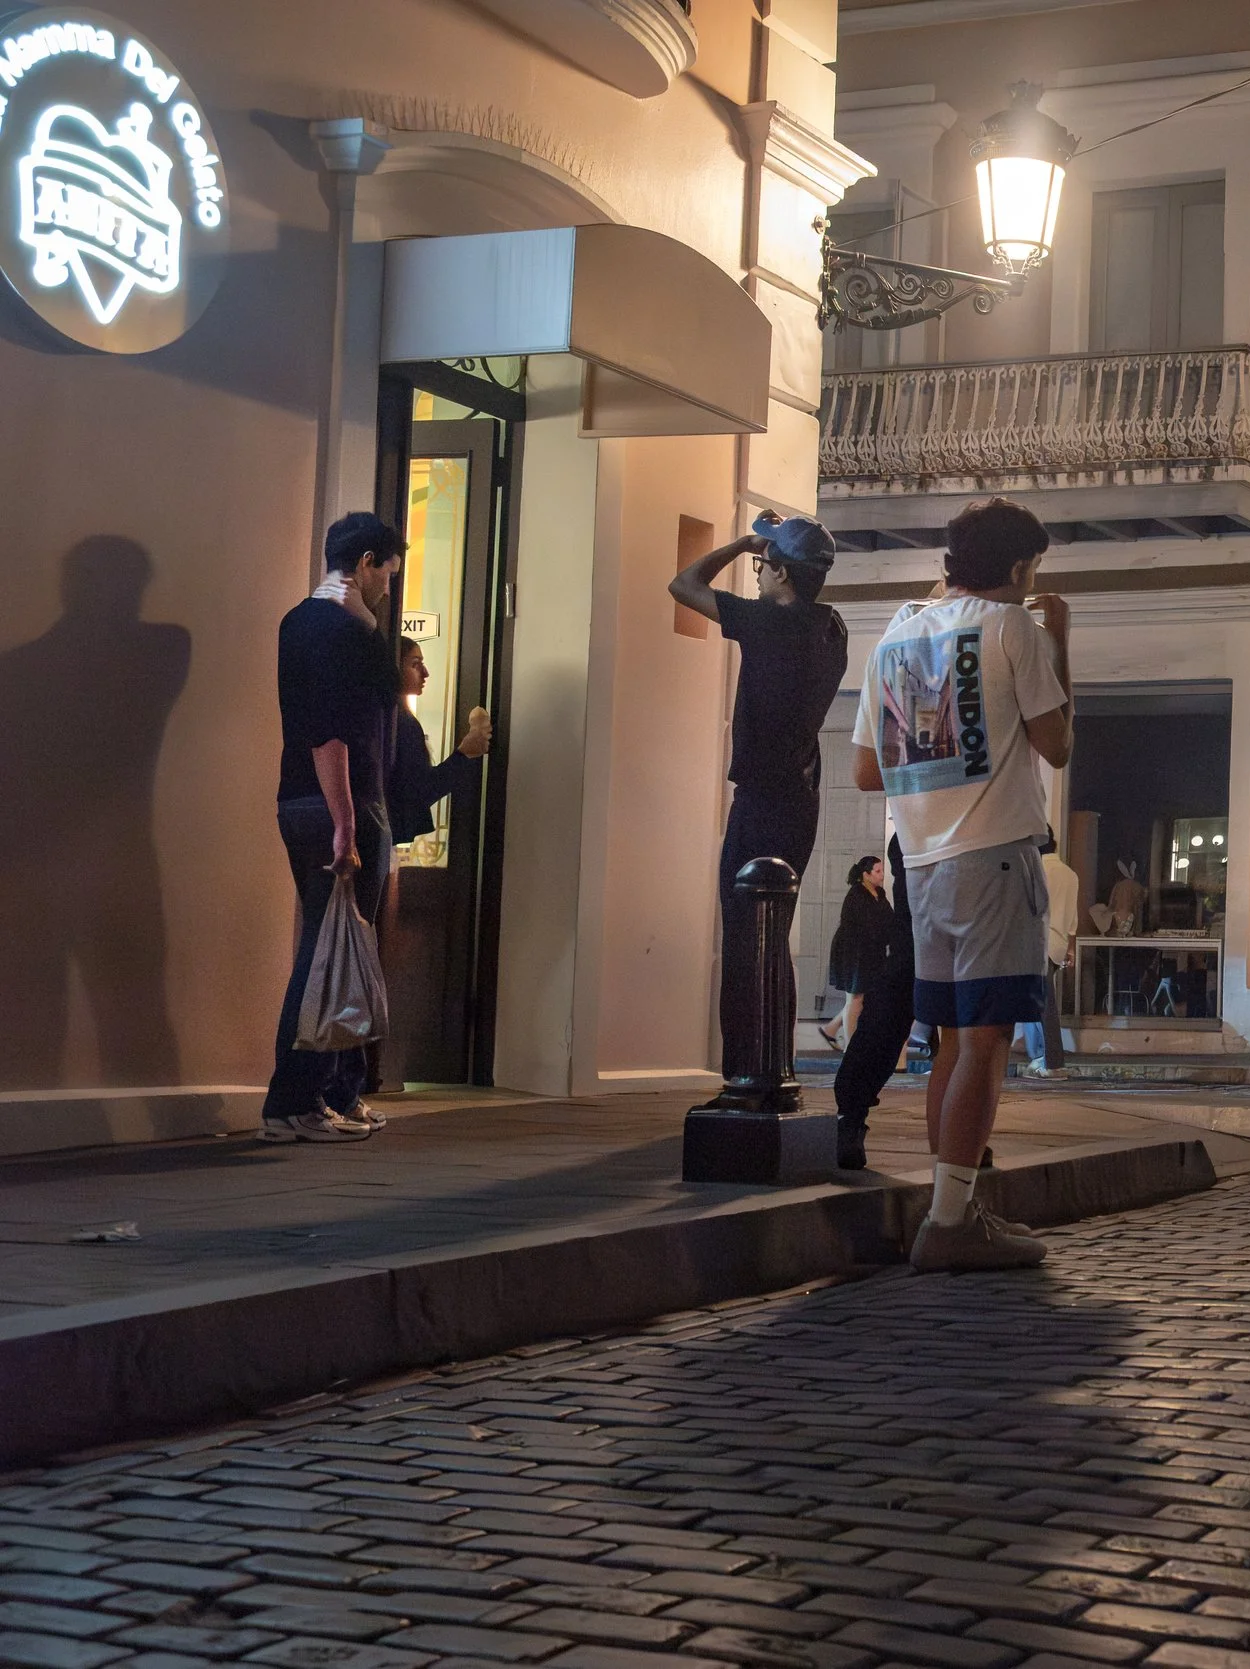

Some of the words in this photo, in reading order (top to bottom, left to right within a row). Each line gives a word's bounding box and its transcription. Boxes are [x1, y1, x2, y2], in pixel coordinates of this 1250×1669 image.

[0, 23, 115, 87] Mamma
[124, 40, 180, 103] Del
[173, 102, 224, 227] Gelato
[402, 620, 426, 632] XIT
[955, 633, 989, 778] LONDON
